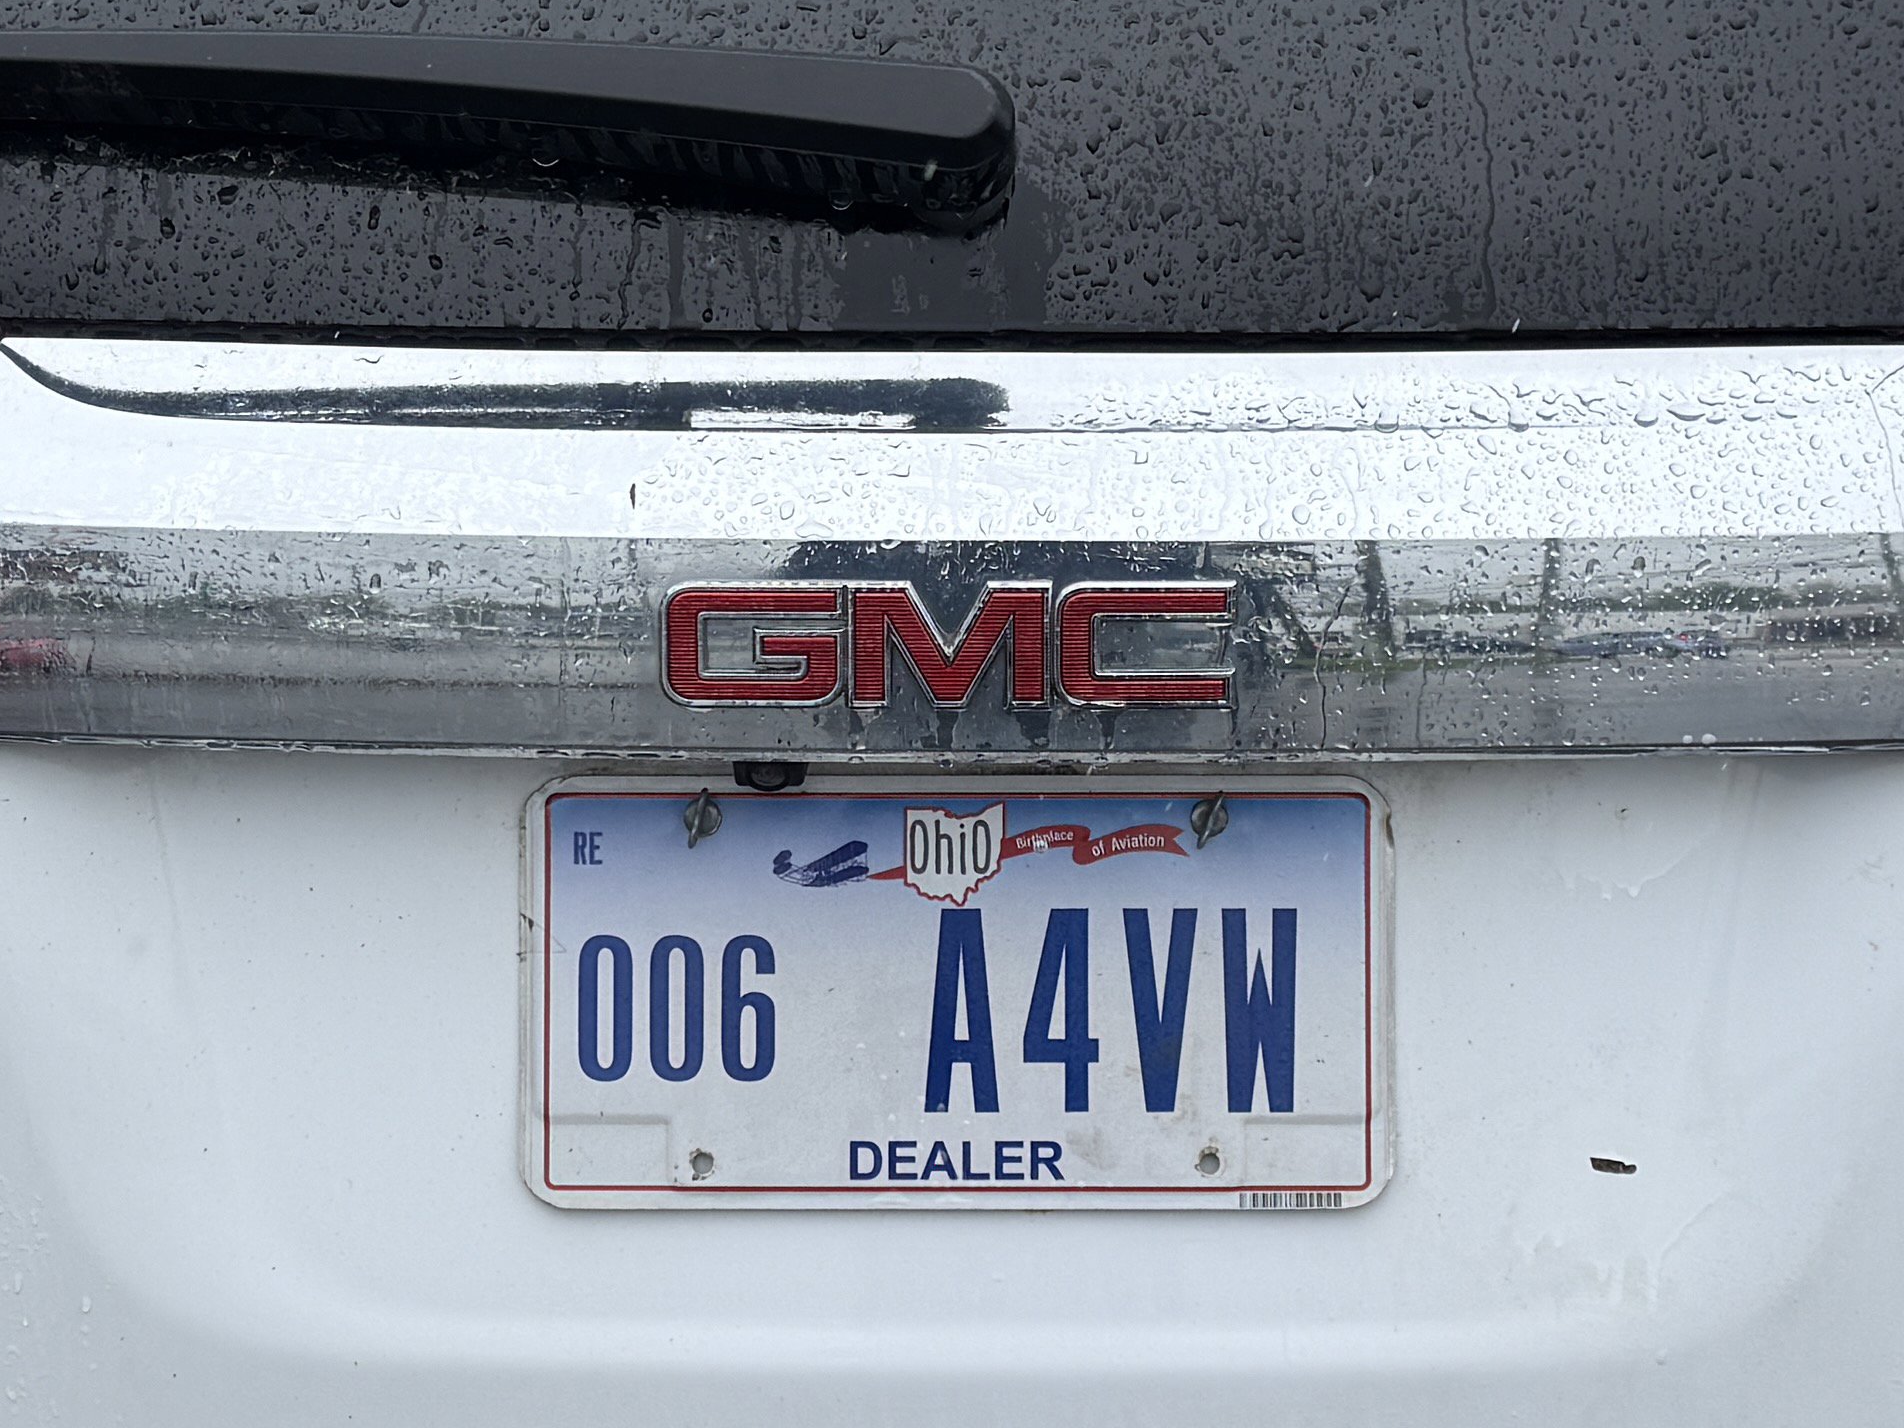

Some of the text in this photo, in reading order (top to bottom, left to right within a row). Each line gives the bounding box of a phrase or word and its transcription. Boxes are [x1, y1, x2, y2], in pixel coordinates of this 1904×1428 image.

[661, 579, 1237, 710] GMC
[573, 831, 604, 865] RE
[1014, 828, 1165, 858] Birthplace of Aviation
[577, 907, 1299, 1113] 006 A4VW
[848, 1139, 1066, 1182] DEALER
